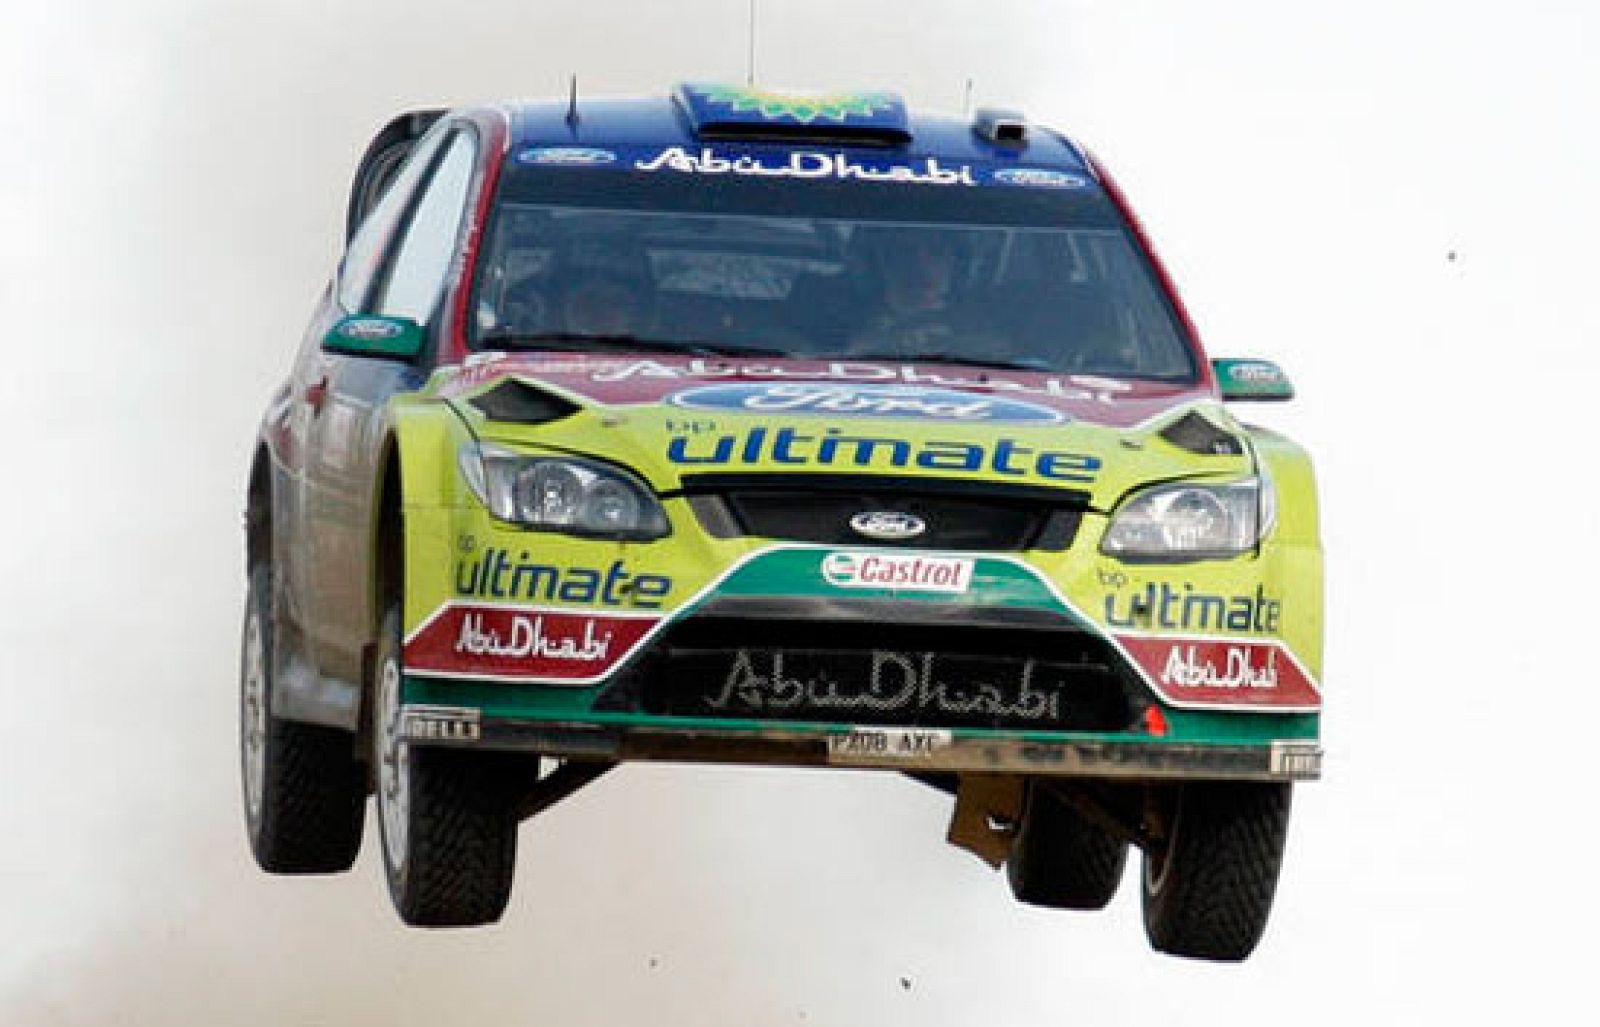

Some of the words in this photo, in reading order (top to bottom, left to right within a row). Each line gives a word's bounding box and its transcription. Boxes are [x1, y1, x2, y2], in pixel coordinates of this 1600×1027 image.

[744, 385, 993, 419] Ford
[666, 426, 1103, 483] ultimate
[456, 548, 673, 608] ultimate
[858, 556, 963, 587] Castrol
[1104, 582, 1281, 632] ultimate
